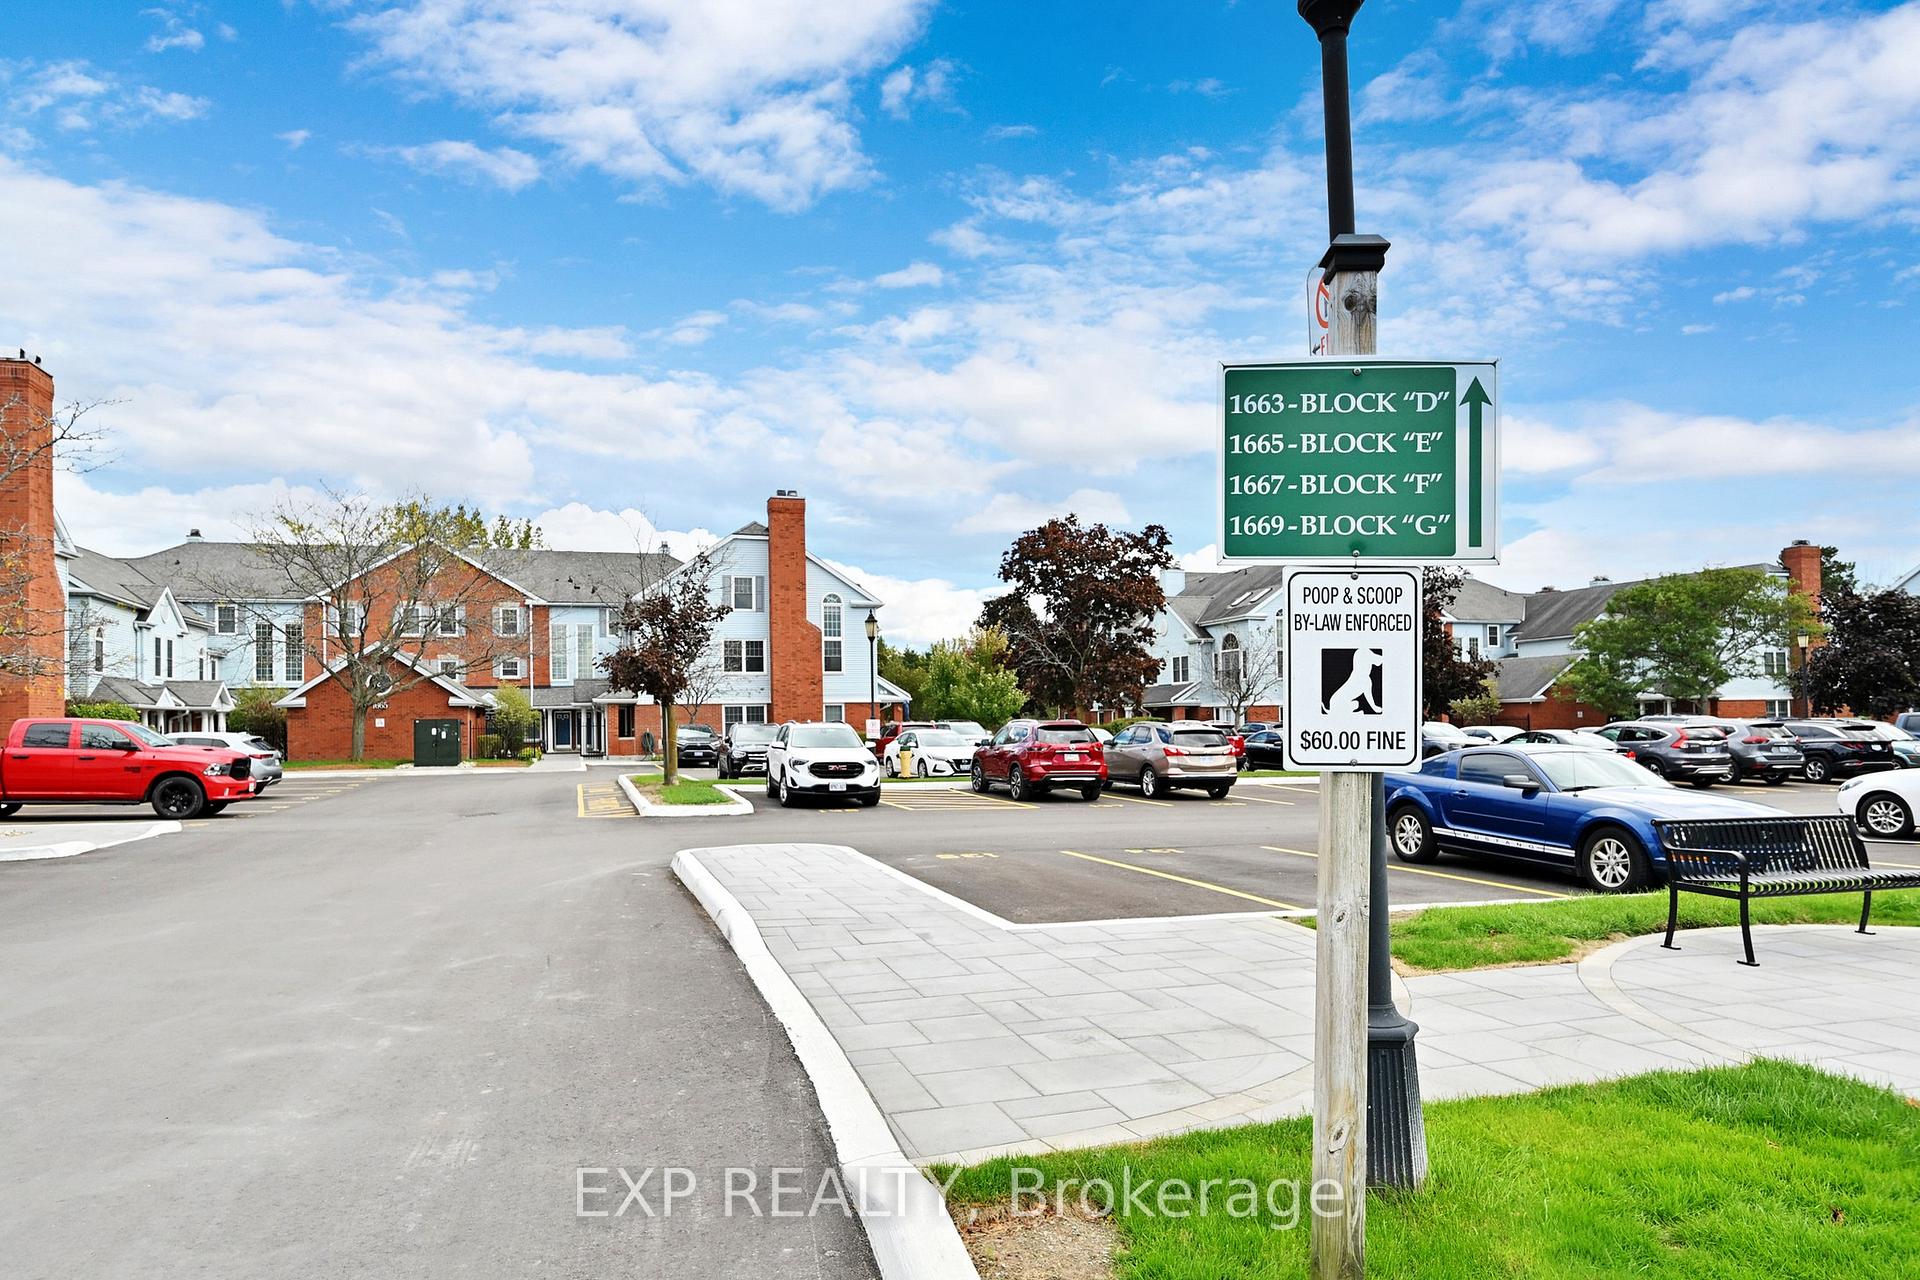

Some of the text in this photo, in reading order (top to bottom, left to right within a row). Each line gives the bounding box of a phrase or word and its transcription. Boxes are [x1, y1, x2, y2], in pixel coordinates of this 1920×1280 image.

[1403, 392, 1449, 412] “D”
[1403, 432, 1443, 452] “E”
[1403, 473, 1442, 493] “F”
[1402, 514, 1450, 535] “G”
[1304, 587, 1402, 604] POOP & SCOOP
[1295, 614, 1411, 631] BY-LAW ENFORCED
[1301, 730, 1405, 751] $60.00 FINE
[1462, 833, 1535, 849] MUSTANG
